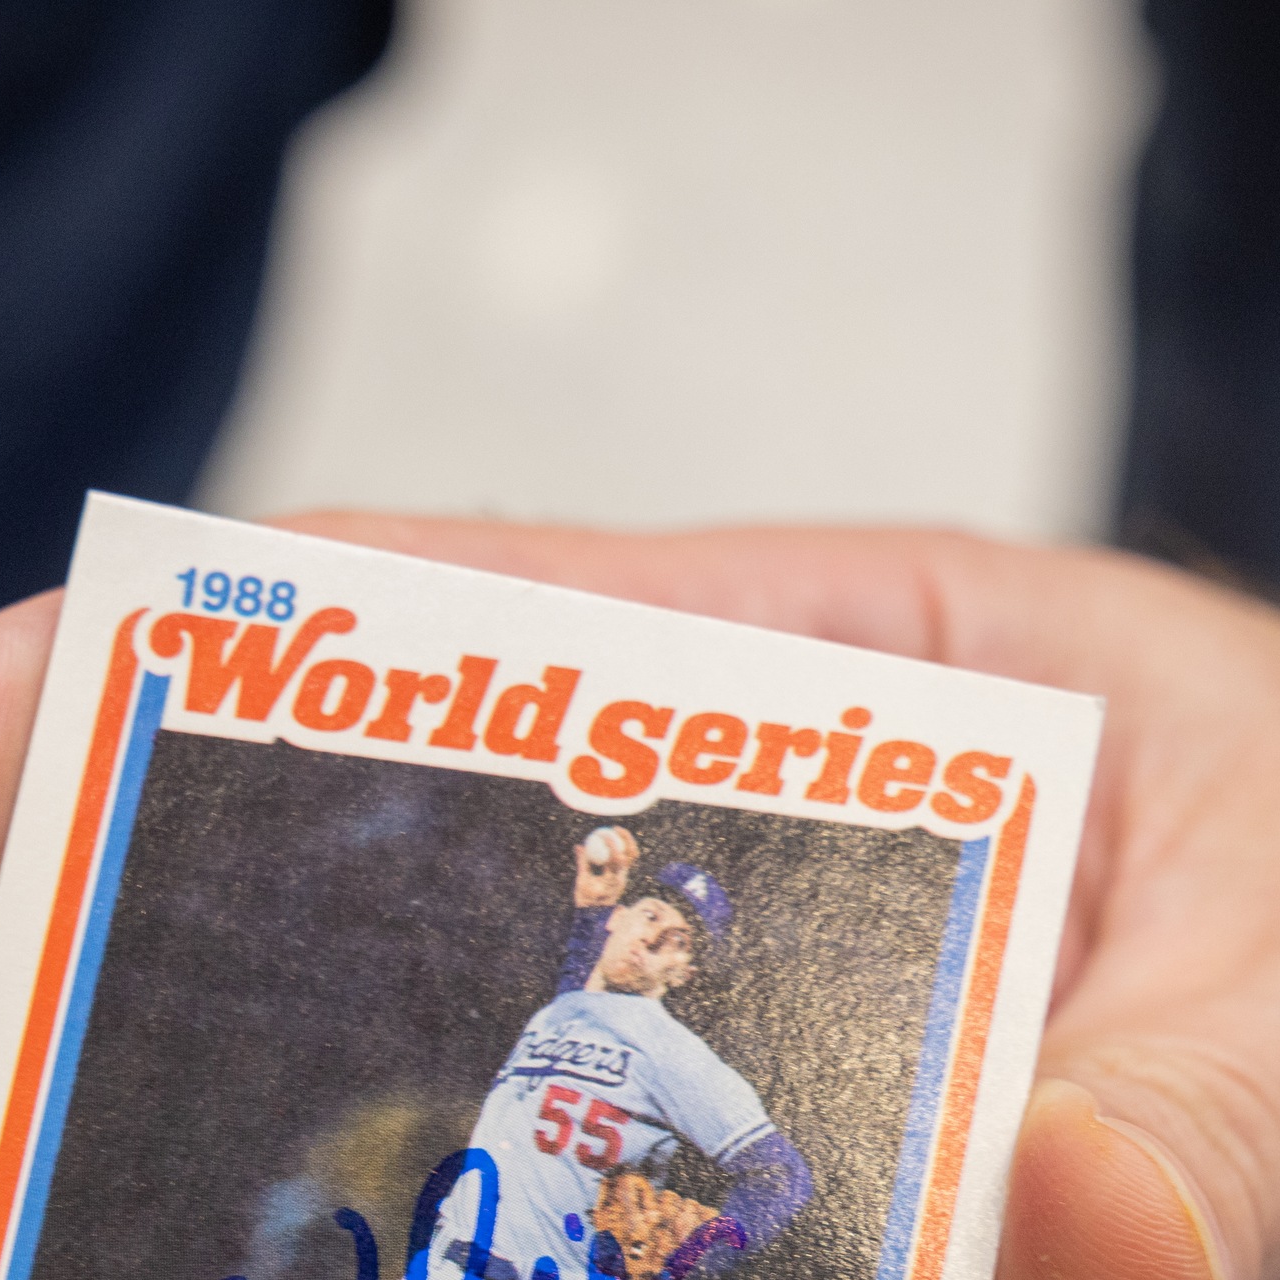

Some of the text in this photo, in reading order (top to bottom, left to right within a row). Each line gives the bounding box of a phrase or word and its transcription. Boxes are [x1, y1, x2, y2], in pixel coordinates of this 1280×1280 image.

[175, 567, 298, 622] 1988
[149, 606, 583, 762] World
[533, 1084, 629, 1170] 55
